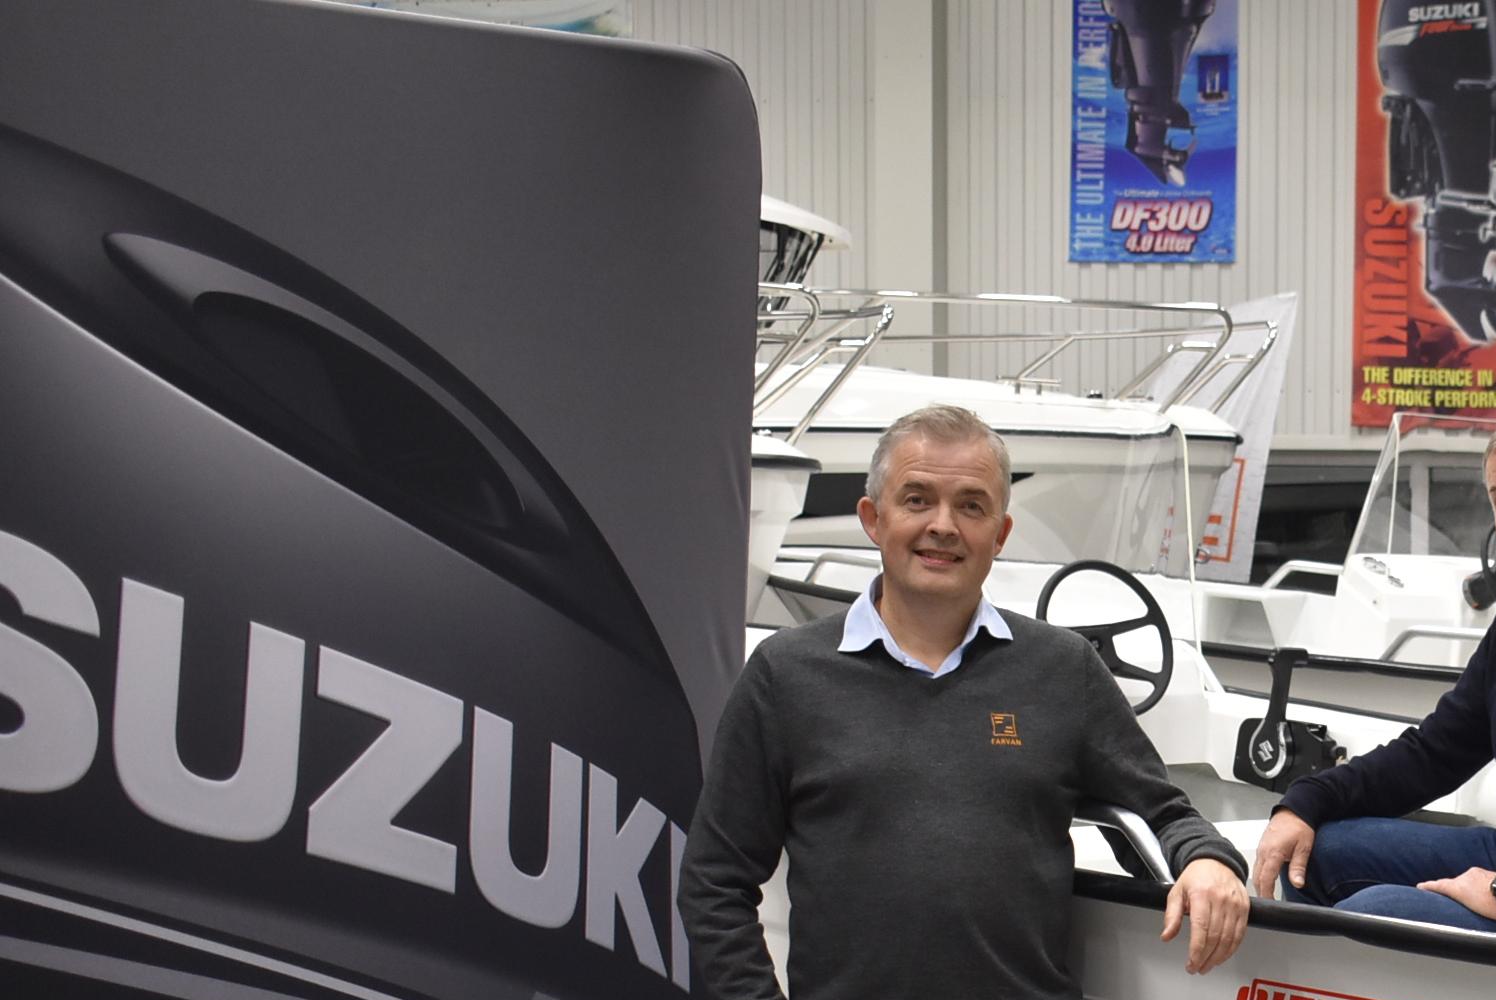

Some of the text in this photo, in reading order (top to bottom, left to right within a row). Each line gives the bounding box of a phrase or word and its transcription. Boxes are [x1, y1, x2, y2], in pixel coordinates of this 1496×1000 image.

[1408, 2, 1480, 22] SUZUKI
[1077, 75, 1107, 99] IN
[1076, 105, 1106, 206] ULTIMATE
[1110, 198, 1214, 232] DF300
[1074, 212, 1105, 251] THE
[1125, 231, 1154, 253] 4.0
[1153, 231, 1198, 253] Liter
[1362, 198, 1408, 357] SUZUKI
[1362, 366, 1493, 387] THE DIFFERENCE IN
[1362, 387, 1432, 406] 4-STROKE
